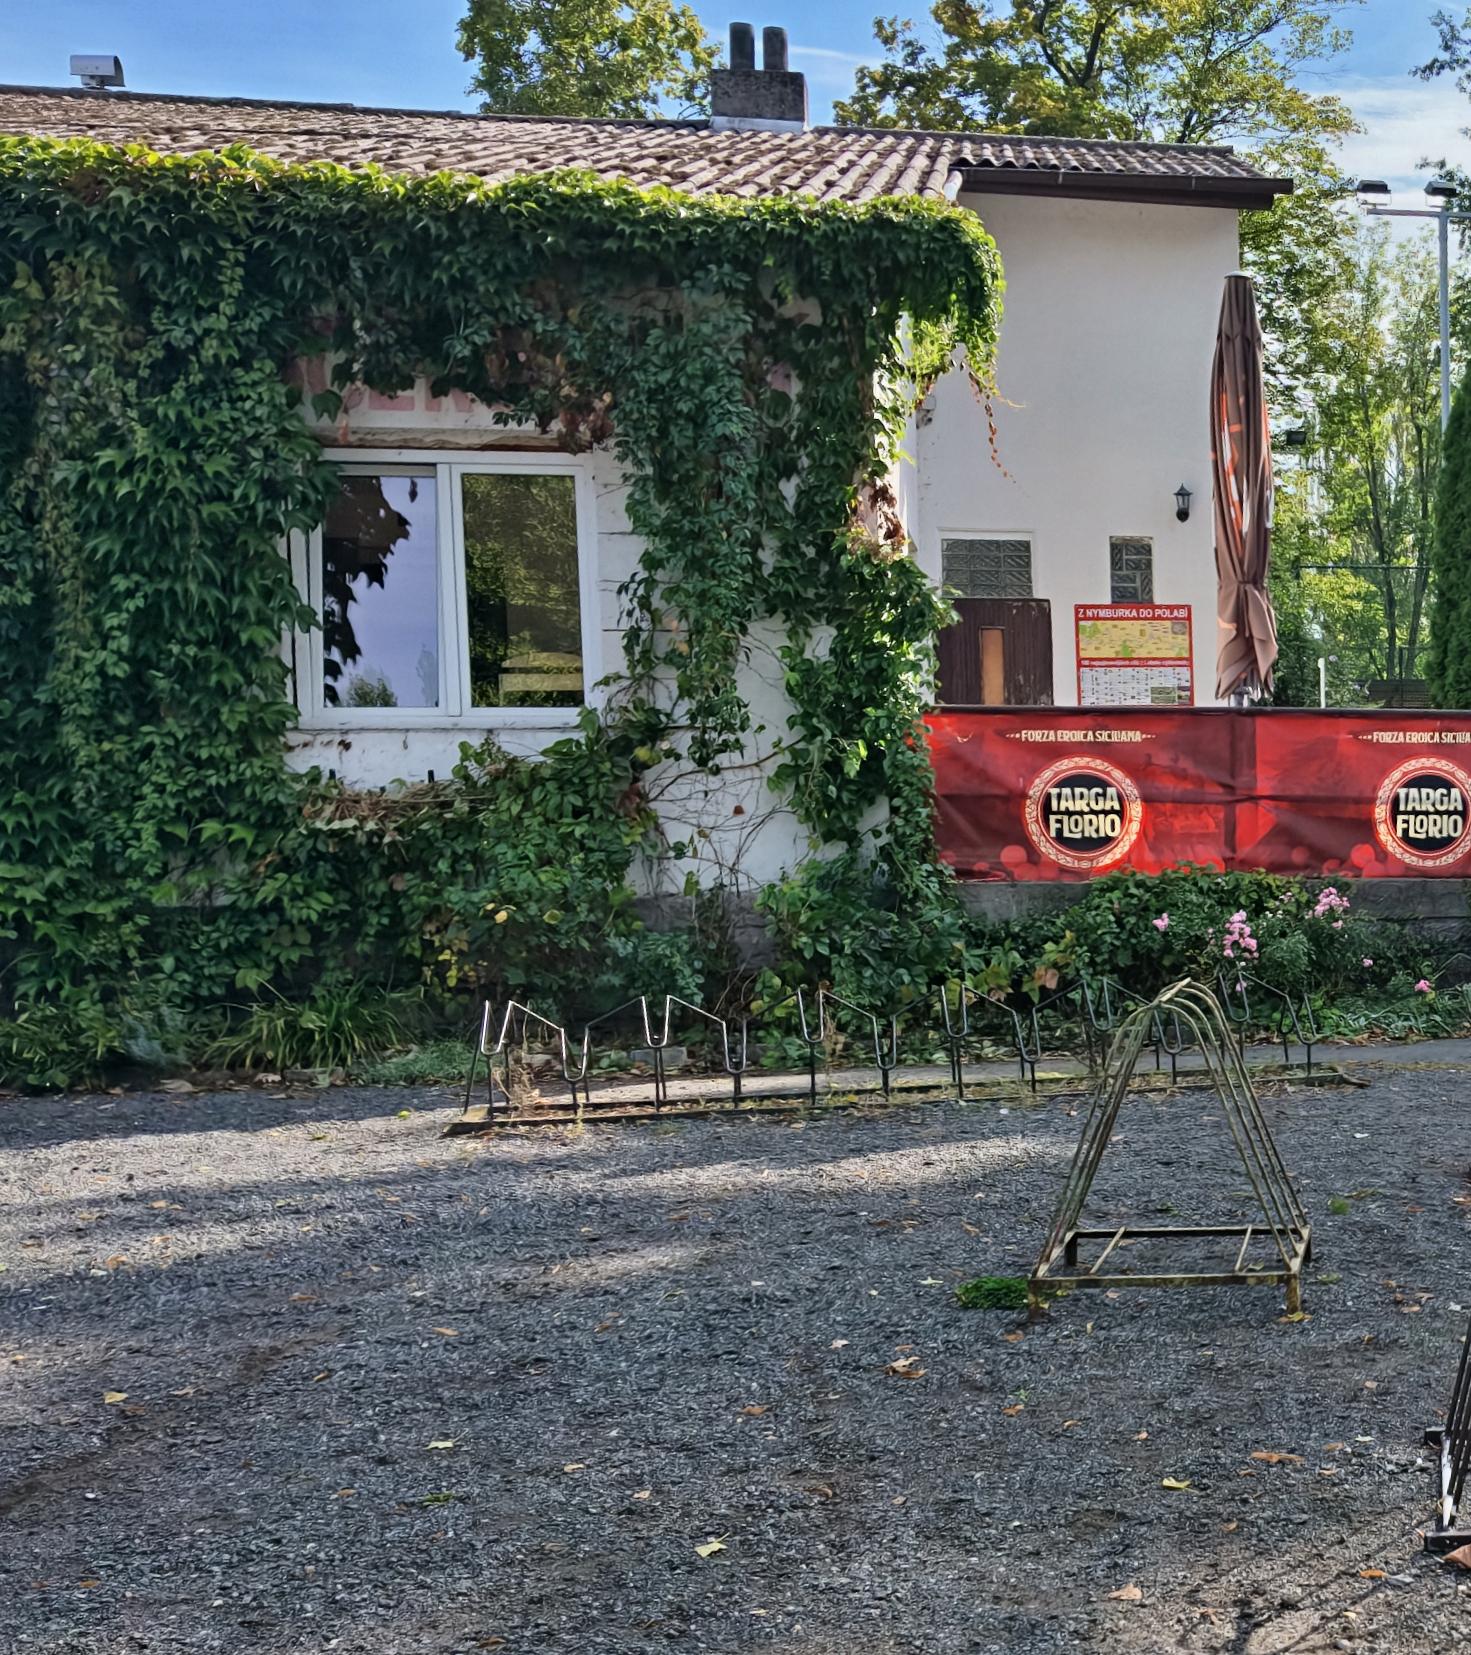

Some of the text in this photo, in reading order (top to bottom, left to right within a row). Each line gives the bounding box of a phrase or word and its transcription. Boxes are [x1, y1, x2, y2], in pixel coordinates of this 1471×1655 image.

[1078, 607, 1188, 618] Z NYMBURKA DO POLABÍ
[1021, 730, 1141, 742] FORZA EROICA SICILIANA
[1373, 731, 1404, 743] FORZA
[1406, 731, 1440, 743] EROICA
[1048, 787, 1121, 812] TARGA
[1396, 787, 1463, 812] TARGA
[1049, 813, 1121, 839] FLORIO
[1396, 814, 1463, 839] FLORIO
